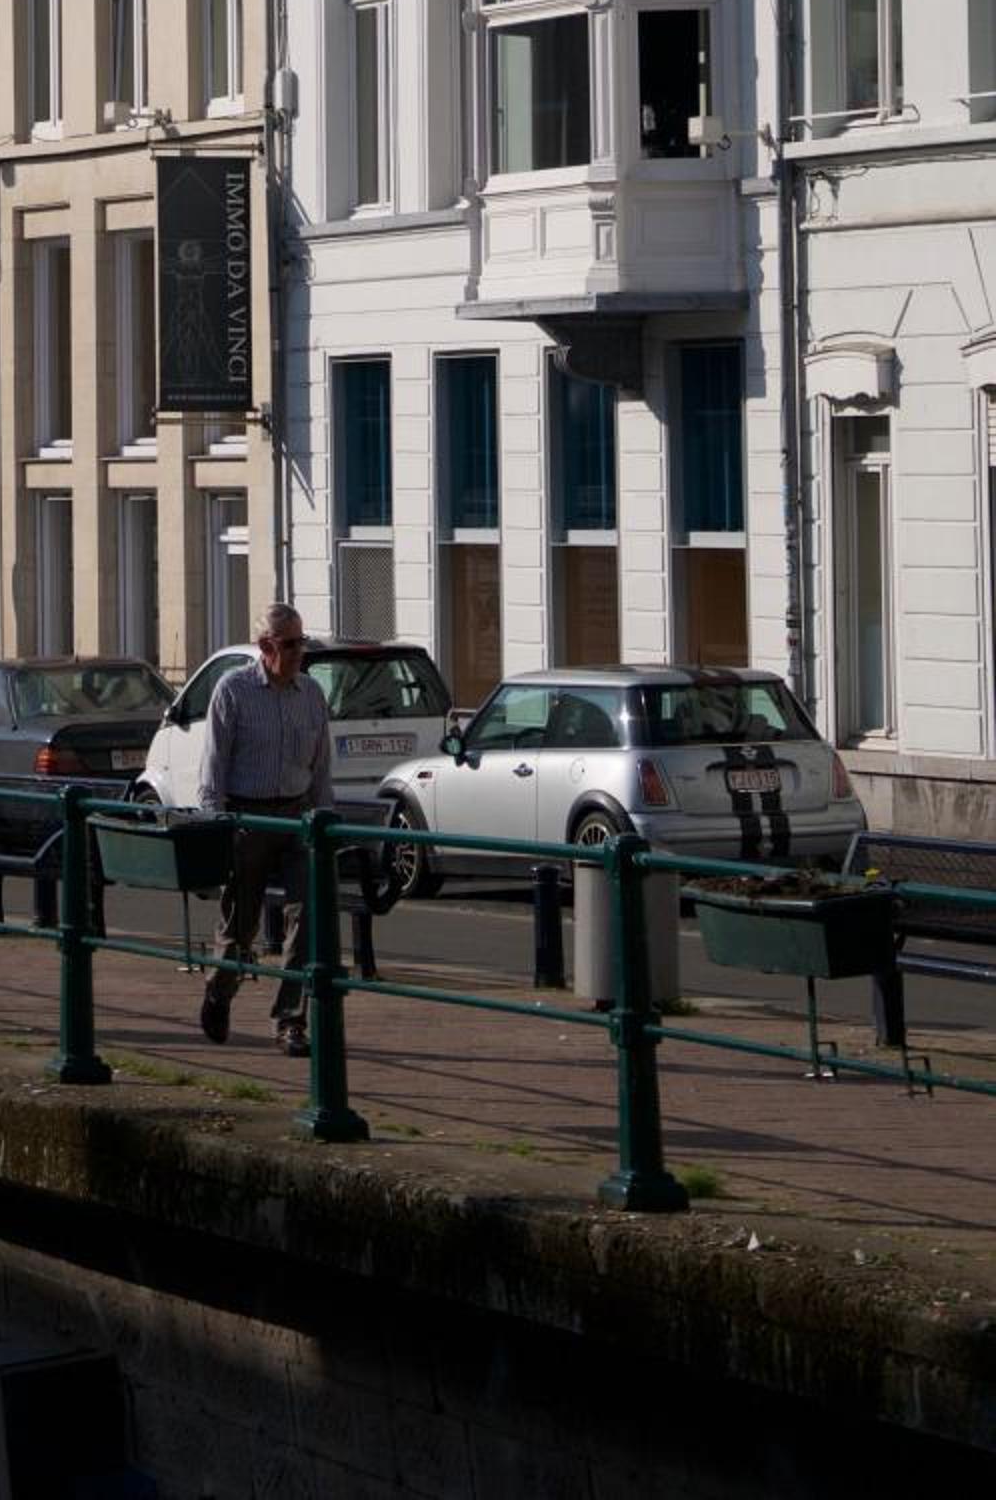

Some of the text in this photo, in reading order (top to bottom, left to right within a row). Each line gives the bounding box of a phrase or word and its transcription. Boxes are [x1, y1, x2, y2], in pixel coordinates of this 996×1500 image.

[225, 172, 248, 383] IMMO DA VINCI
